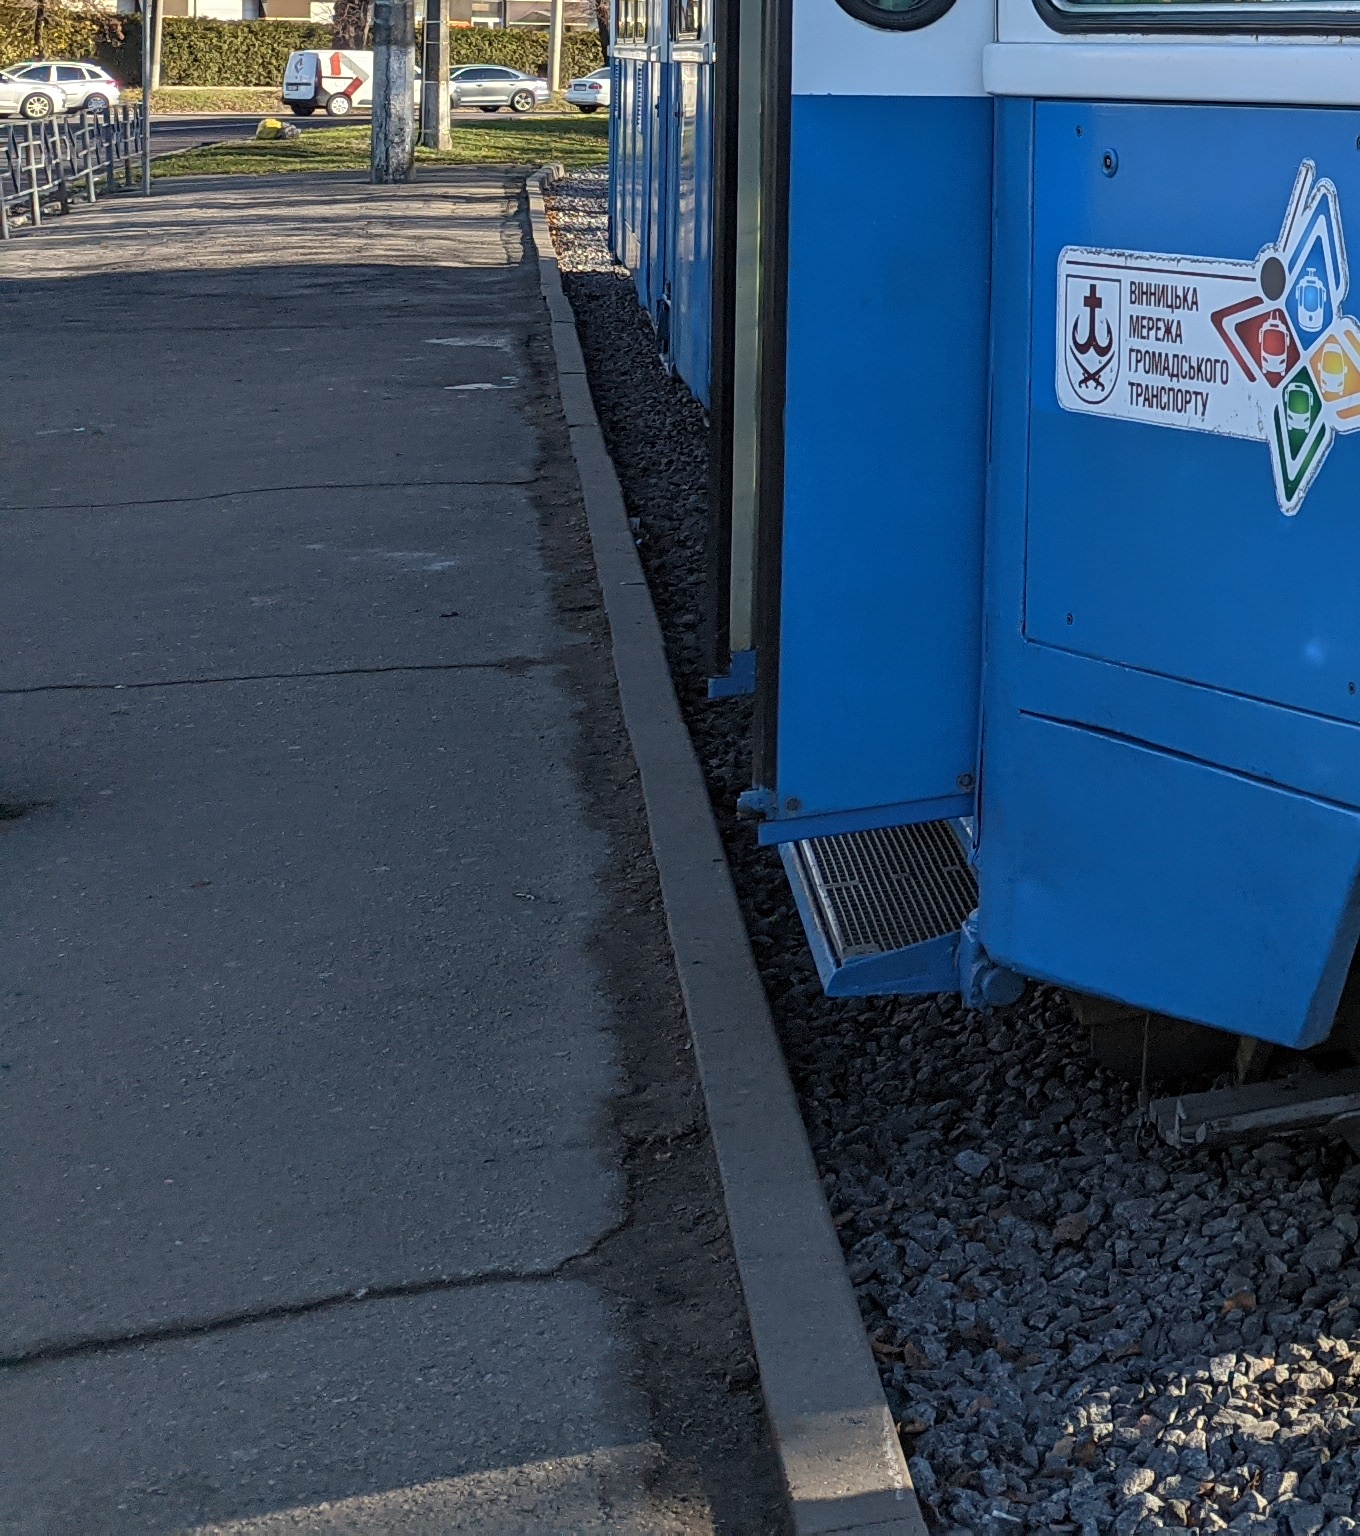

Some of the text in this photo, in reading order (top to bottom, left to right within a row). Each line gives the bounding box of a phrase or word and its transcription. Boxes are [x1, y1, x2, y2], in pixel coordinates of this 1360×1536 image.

[1129, 280, 1199, 314] ВІННИЦЬКА
[1128, 314, 1183, 344] МЕРЕЖА
[1128, 348, 1229, 385] ГРОМАДСЬКОГО
[1128, 380, 1210, 417] ТРАНСПОРТУ
